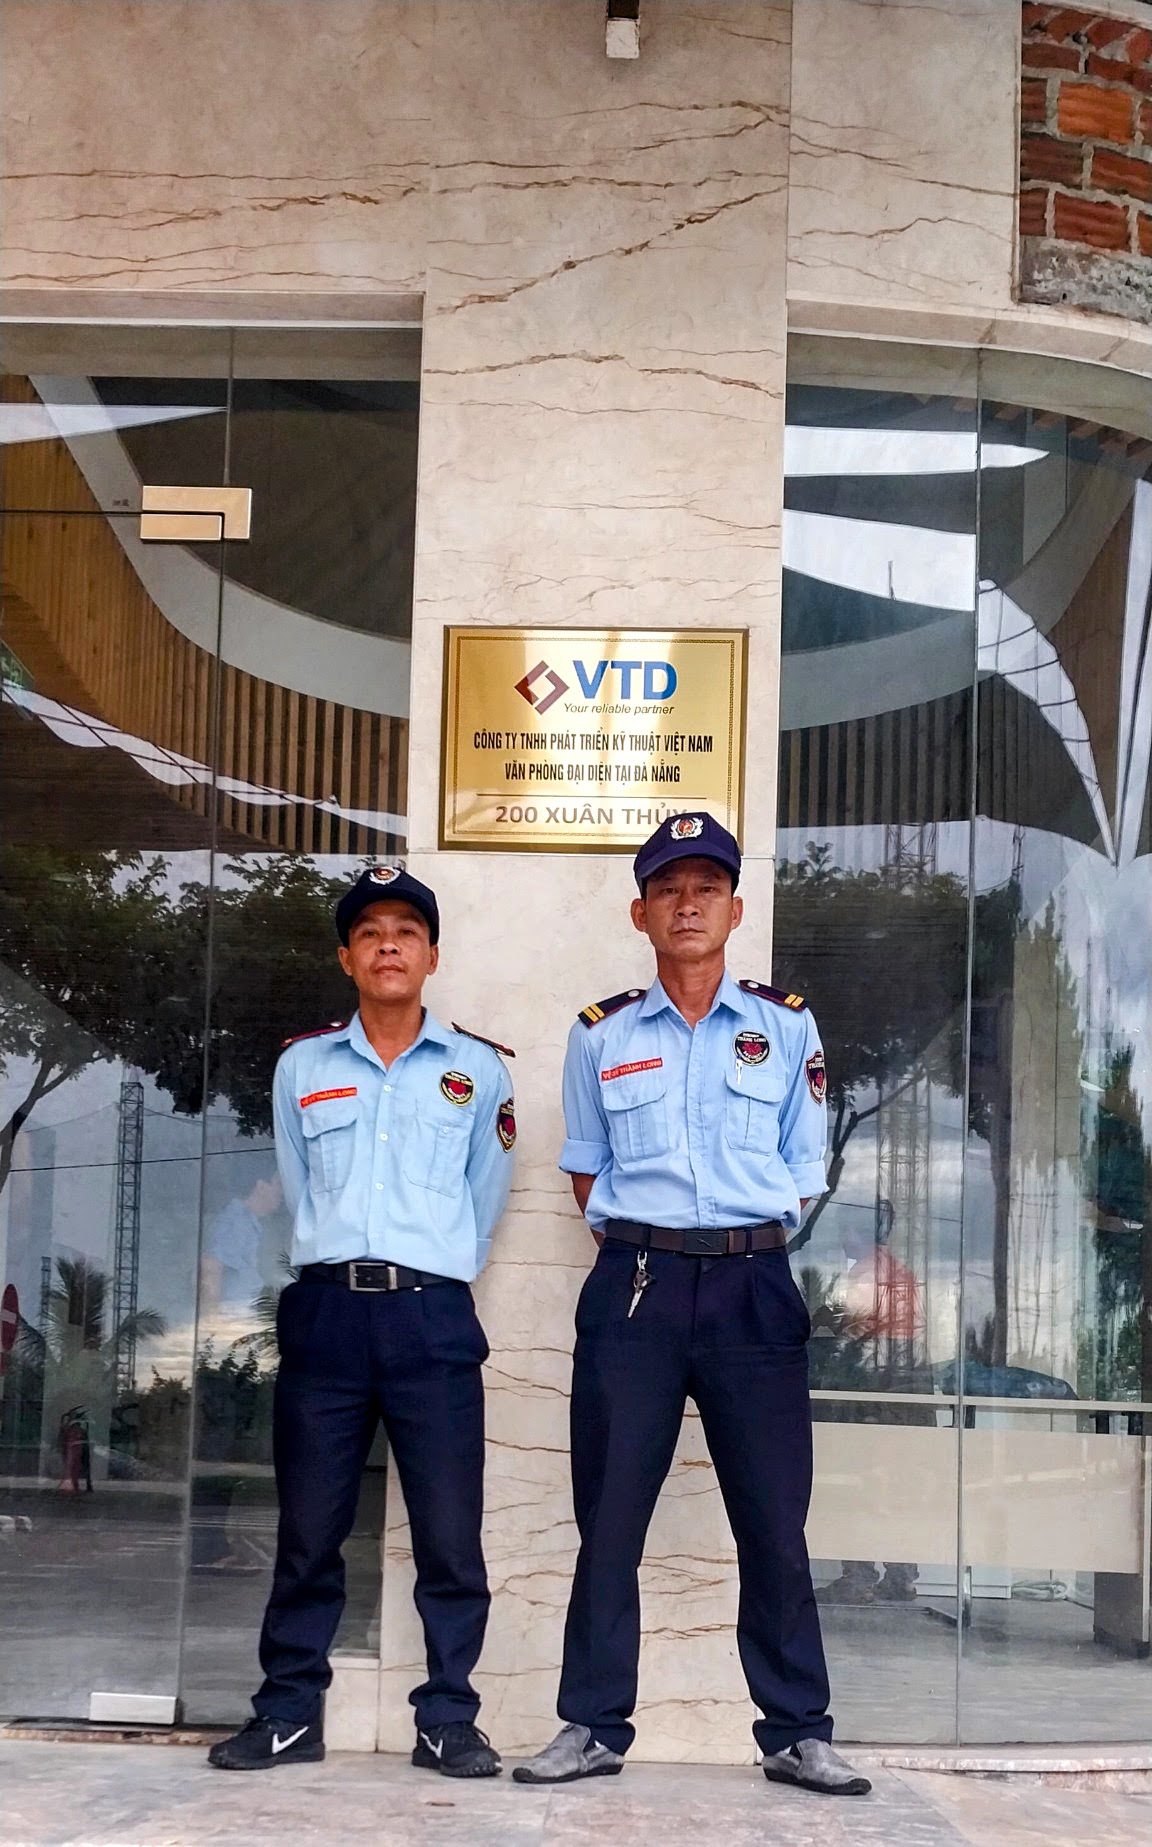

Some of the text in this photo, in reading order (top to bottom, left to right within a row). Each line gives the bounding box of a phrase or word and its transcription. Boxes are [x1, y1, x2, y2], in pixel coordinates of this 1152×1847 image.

[572, 659, 678, 700] VTD
[564, 702, 674, 716] Your reliable partner
[473, 727, 713, 756] CÔNG TY TNHH PHÁT TRIỂN KỸ THUẬT VIỆT NAM
[505, 761, 526, 780] VĂN
[529, 761, 564, 781] PHÒNG
[567, 764, 584, 785] ĐẠI
[588, 761, 612, 785] DIỆN
[615, 764, 631, 786] TẠI
[634, 763, 648, 782] ĐÀ
[495, 802, 688, 825] 200 XUÂN THỦ
